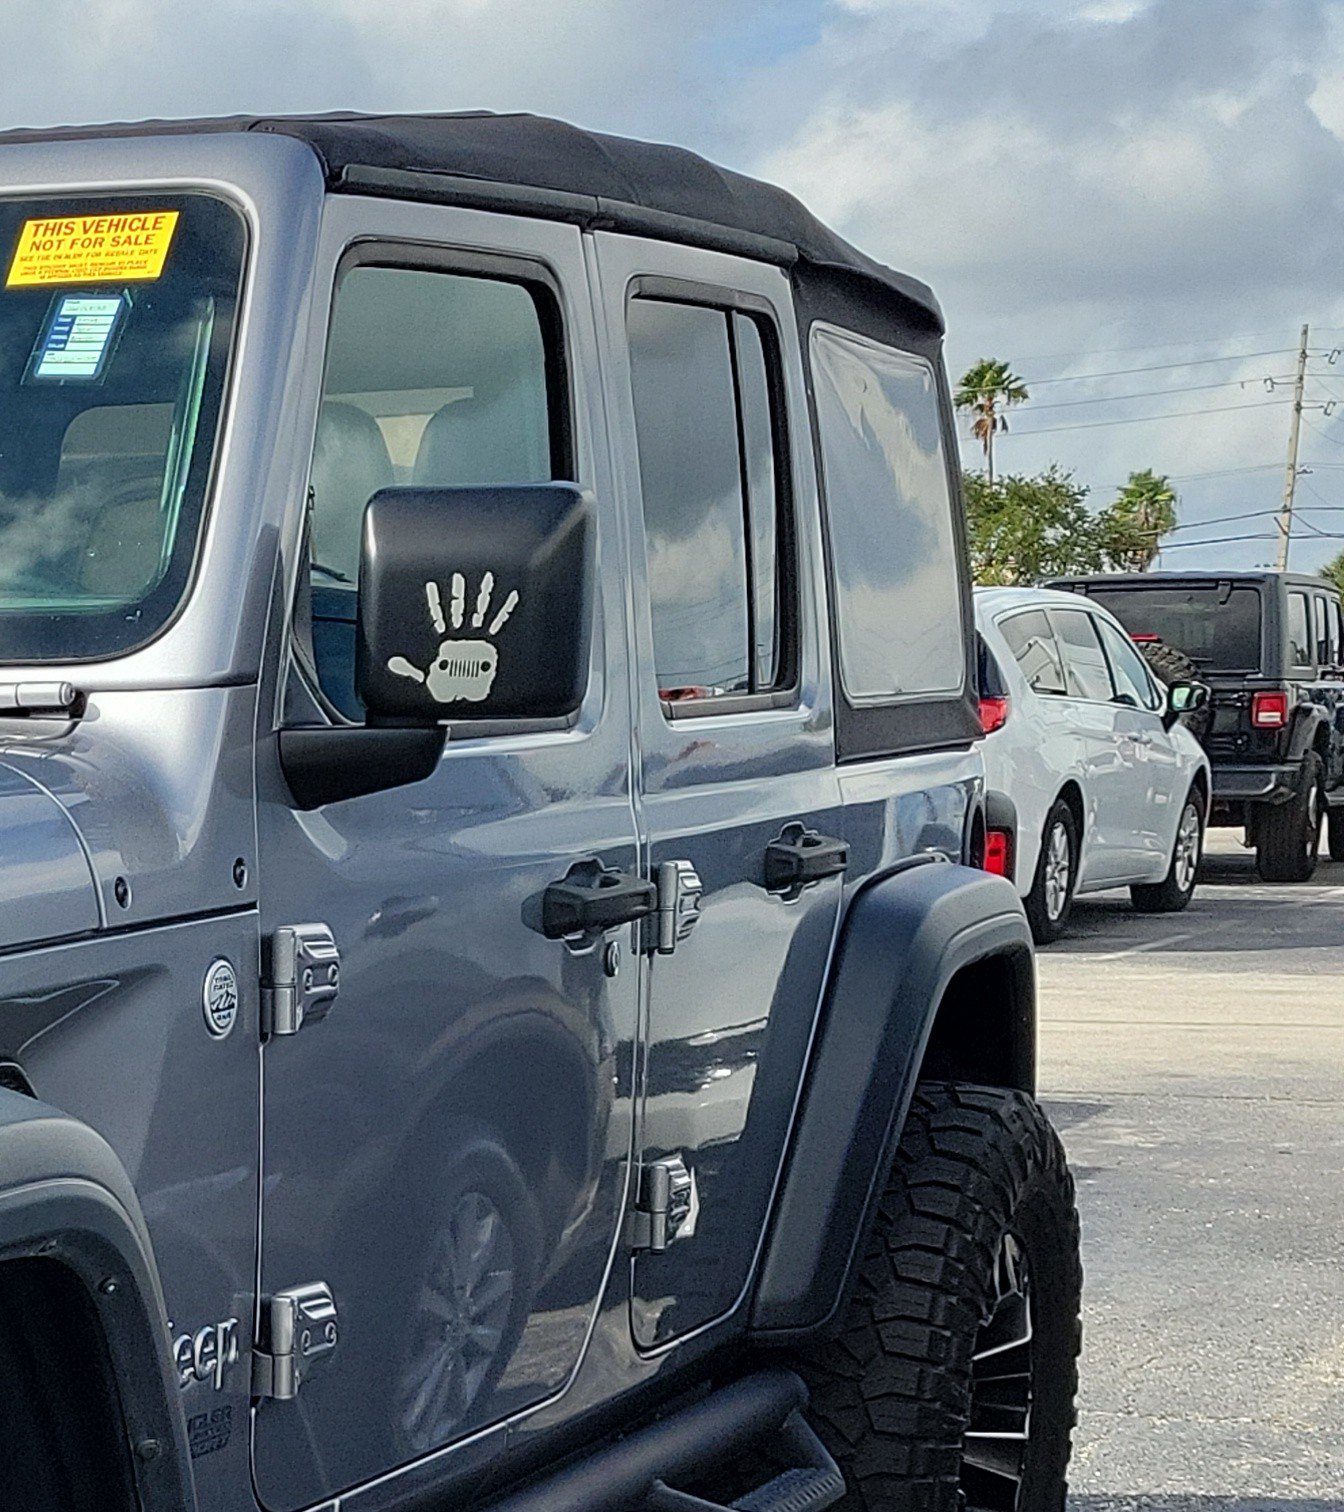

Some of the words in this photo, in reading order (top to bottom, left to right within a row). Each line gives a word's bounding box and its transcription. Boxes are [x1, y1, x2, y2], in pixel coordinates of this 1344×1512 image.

[32, 221, 76, 238] THIS
[82, 216, 166, 235] VEHICLE
[30, 239, 65, 252] NOT
[69, 237, 105, 250] FOR
[110, 234, 155, 247] SALE
[167, 1317, 239, 1391] eep
